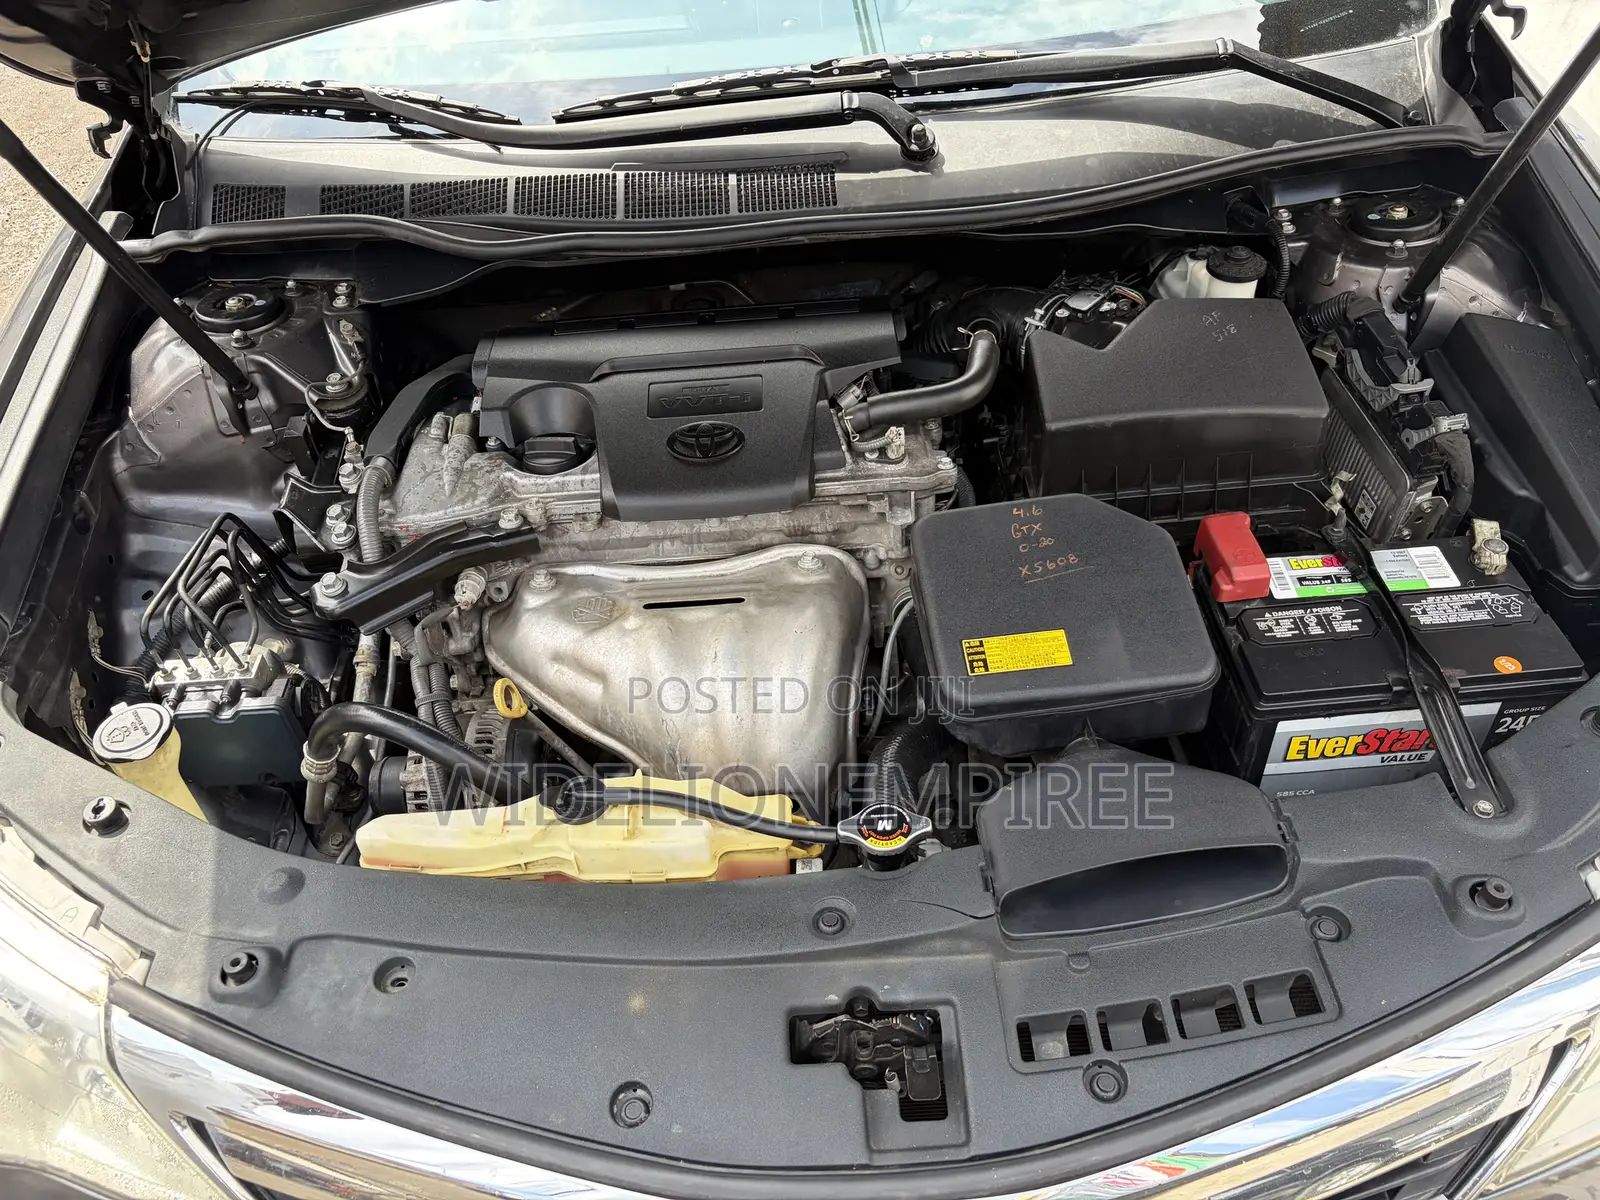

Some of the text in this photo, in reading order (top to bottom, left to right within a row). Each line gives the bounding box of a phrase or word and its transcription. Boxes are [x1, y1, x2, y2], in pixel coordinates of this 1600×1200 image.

[1012, 504, 1043, 518] 4.6
[1011, 522, 1042, 539] GTX
[1288, 556, 1343, 571] EverSt
[1271, 608, 1305, 617] DANGER
[1312, 605, 1343, 614] POISON
[1285, 728, 1436, 761] EverStar
[1380, 752, 1428, 764] VALUE
[1276, 790, 1296, 798] 585
